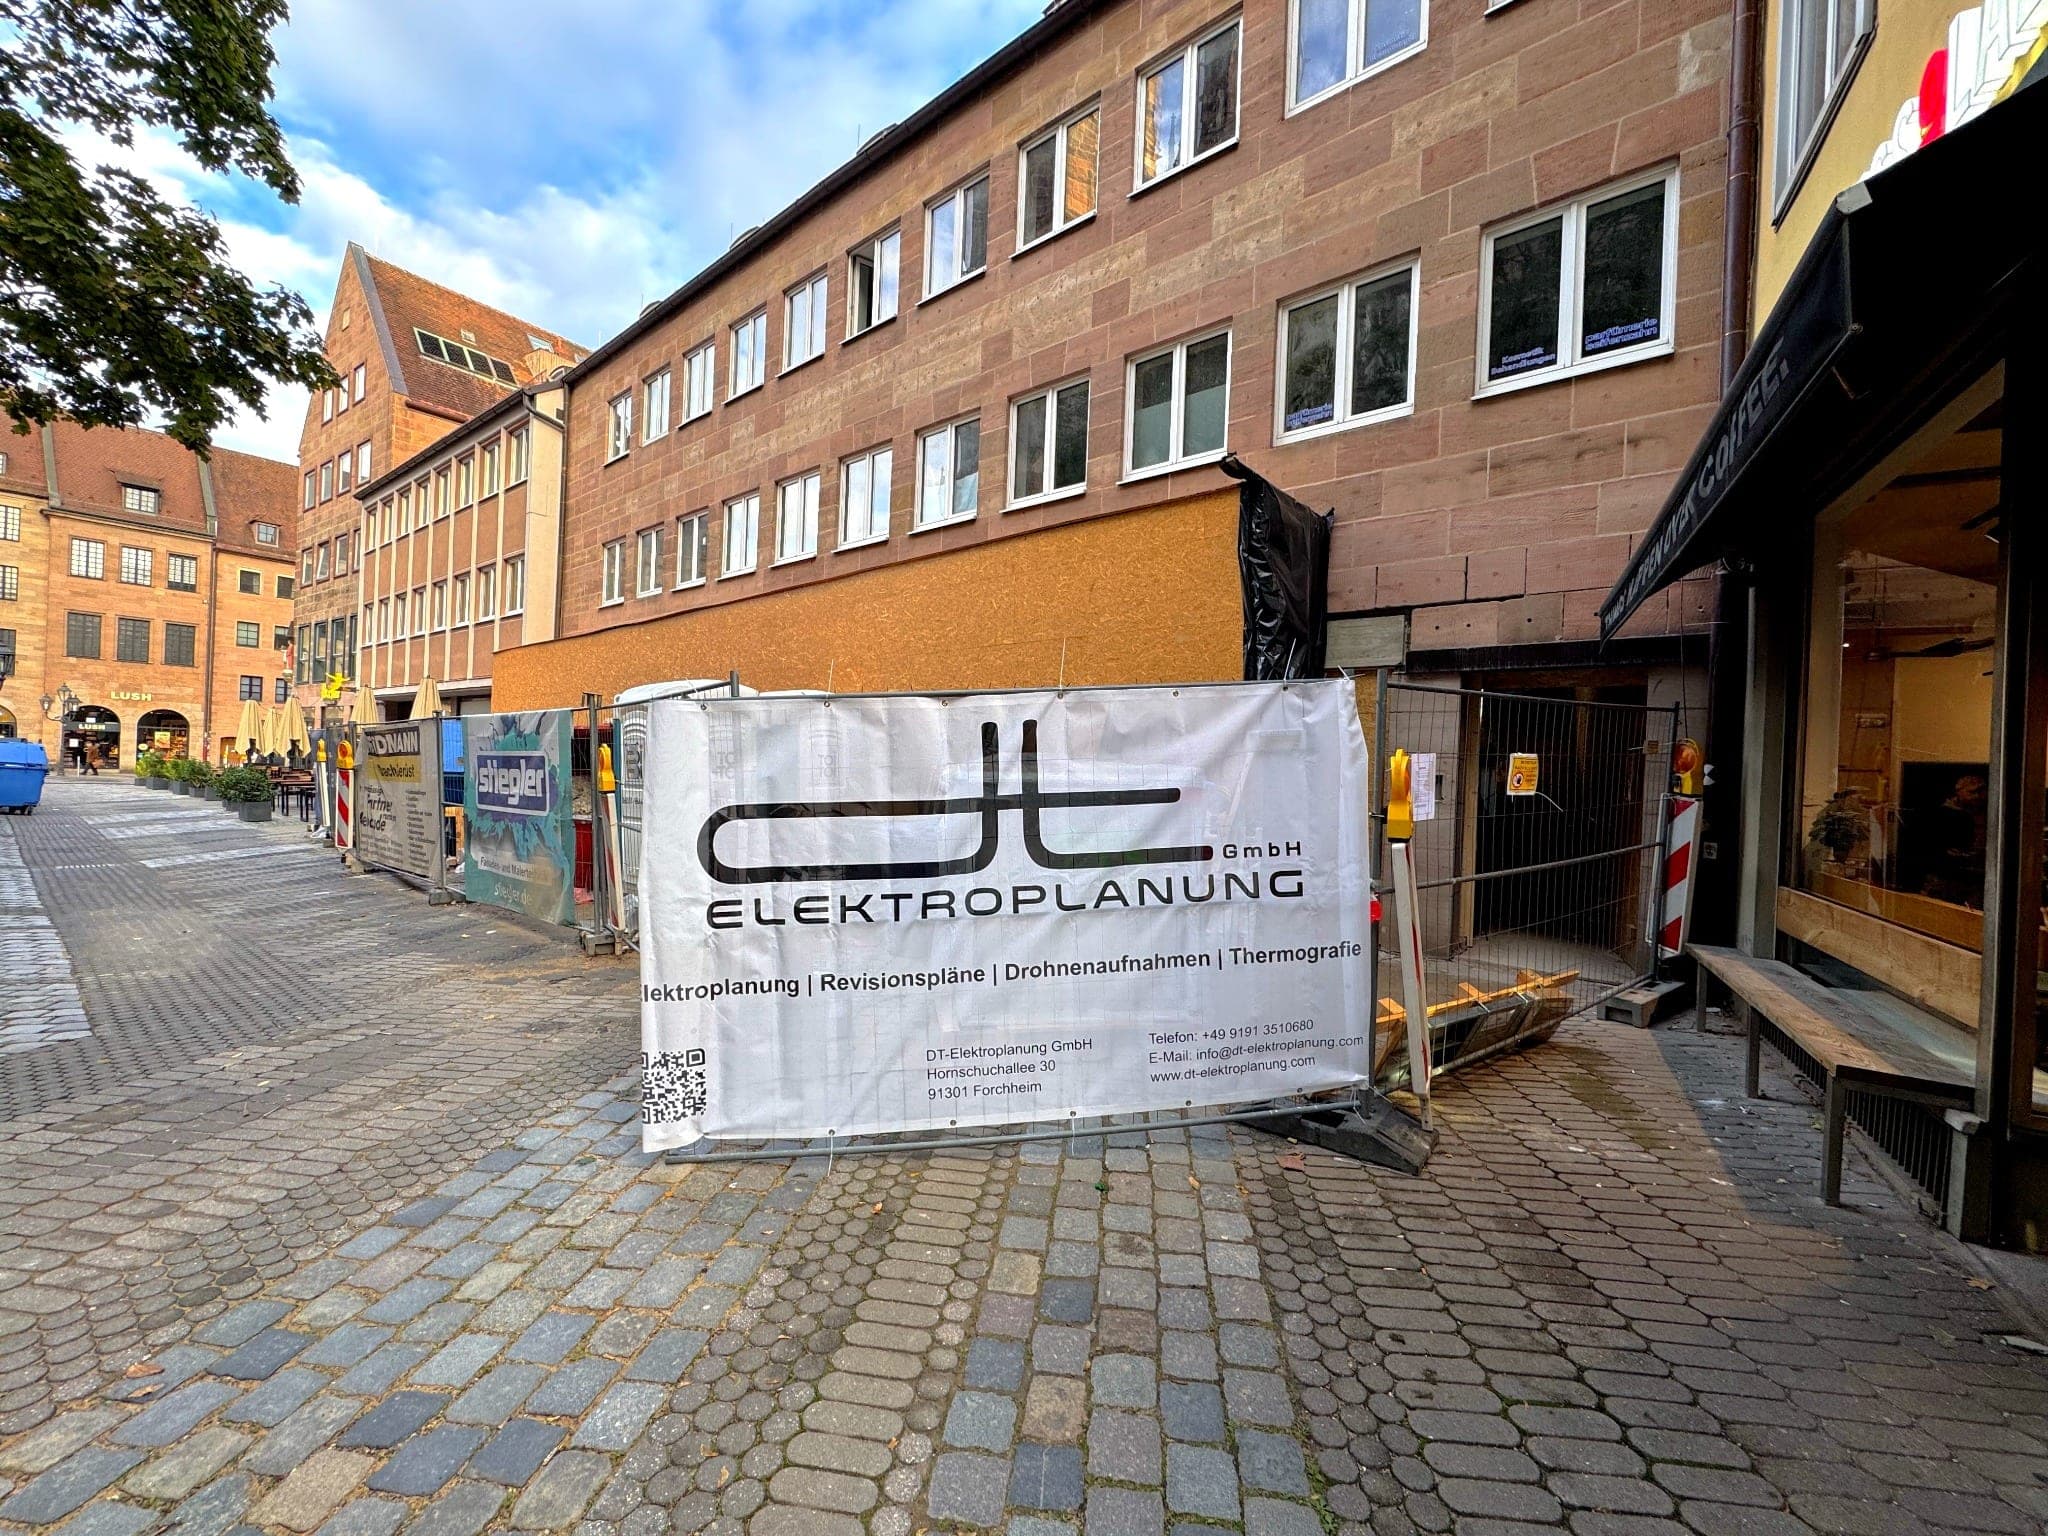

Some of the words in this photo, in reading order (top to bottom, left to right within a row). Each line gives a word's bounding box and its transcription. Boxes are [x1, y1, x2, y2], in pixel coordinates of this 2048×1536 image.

[110, 691, 152, 701] LUSH
[478, 759, 544, 805] stiegler
[1222, 841, 1302, 859] GmbH
[706, 870, 1304, 930] ELEKTROPLANUNG
[641, 977, 800, 1002] lektroplanung
[821, 967, 986, 992] Revisionspläne
[1005, 951, 1210, 981] Drohnenaufnahmen
[1229, 940, 1362, 966] Thermografie
[1149, 1031, 1198, 1045] Telefon:
[1202, 1028, 1226, 1041] +49
[1230, 1025, 1259, 1039] 9191
[1263, 1019, 1314, 1036] 3510680
[926, 1044, 1047, 1062] DT-Elektroplanung
[1051, 1038, 1093, 1052] GmbH
[1149, 1050, 1193, 1064] E-Mail:
[1196, 1035, 1364, 1061] info@dt-elektroplanung.com
[927, 1062, 1036, 1080] Hornschuchallee
[1040, 1060, 1056, 1072] 30
[1150, 1055, 1316, 1082] www.dt-elektroplanung.com
[928, 1086, 968, 1100] 91301
[973, 1081, 1042, 1097] Forchheim
